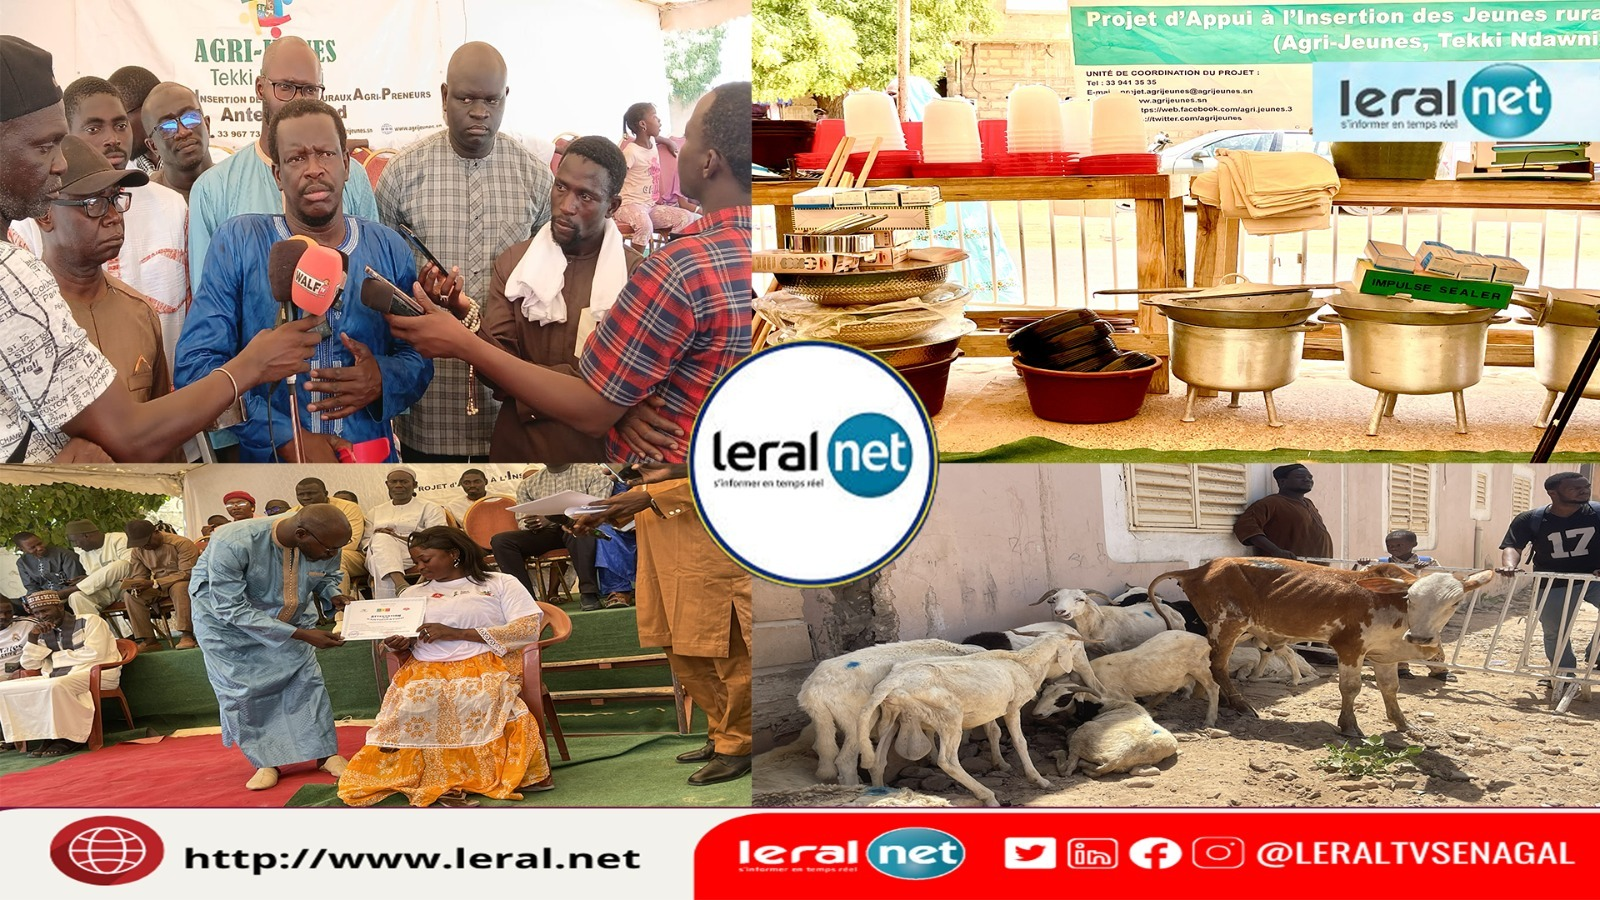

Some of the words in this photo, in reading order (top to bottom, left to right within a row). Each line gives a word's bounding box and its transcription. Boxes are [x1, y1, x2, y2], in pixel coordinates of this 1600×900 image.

[1086, 10, 1157, 30] Projet
[1165, 9, 1252, 29] d'Appui
[1261, 10, 1275, 25] à
[1283, 7, 1404, 26] l'Insertion
[1412, 8, 1455, 24] des
[1463, 7, 1547, 23] Jeunes
[194, 38, 337, 63] AGRI-ES
[1273, 33, 1430, 54] (Agri-Jeunes,
[1438, 32, 1502, 48] Tekki
[210, 68, 253, 86] Tekki
[1141, 105, 1293, 114] tps://web.facebook.com/agri.jeunes.3
[294, 270, 322, 293] WALF
[1371, 278, 1433, 292] IMPULSE
[1439, 286, 1501, 301] SEALER
[418, 483, 448, 492] ROJET
[1547, 526, 1596, 559] 17
